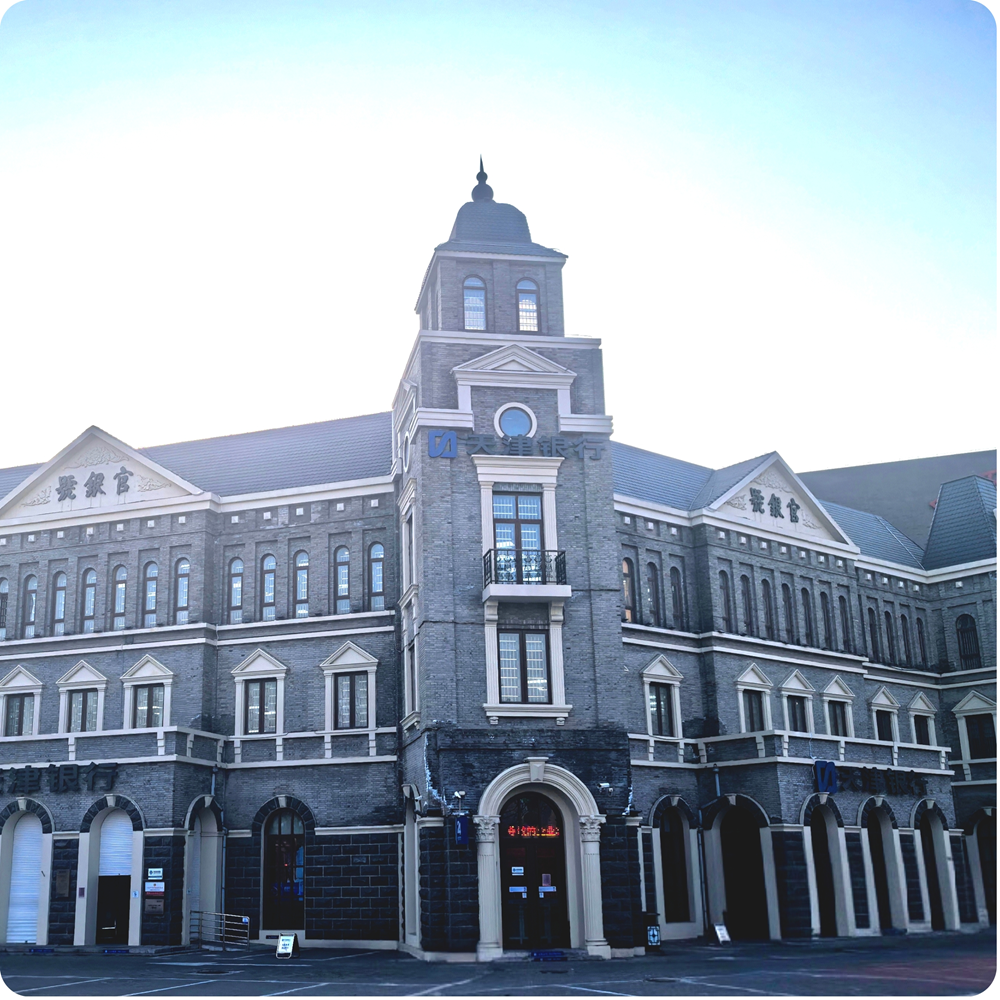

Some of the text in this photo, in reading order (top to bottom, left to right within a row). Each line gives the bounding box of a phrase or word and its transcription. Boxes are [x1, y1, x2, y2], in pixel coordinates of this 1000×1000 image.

[464, 433, 607, 461] 天津银行
[0, 762, 119, 795] 津银行
[836, 766, 929, 796] 天津银行
